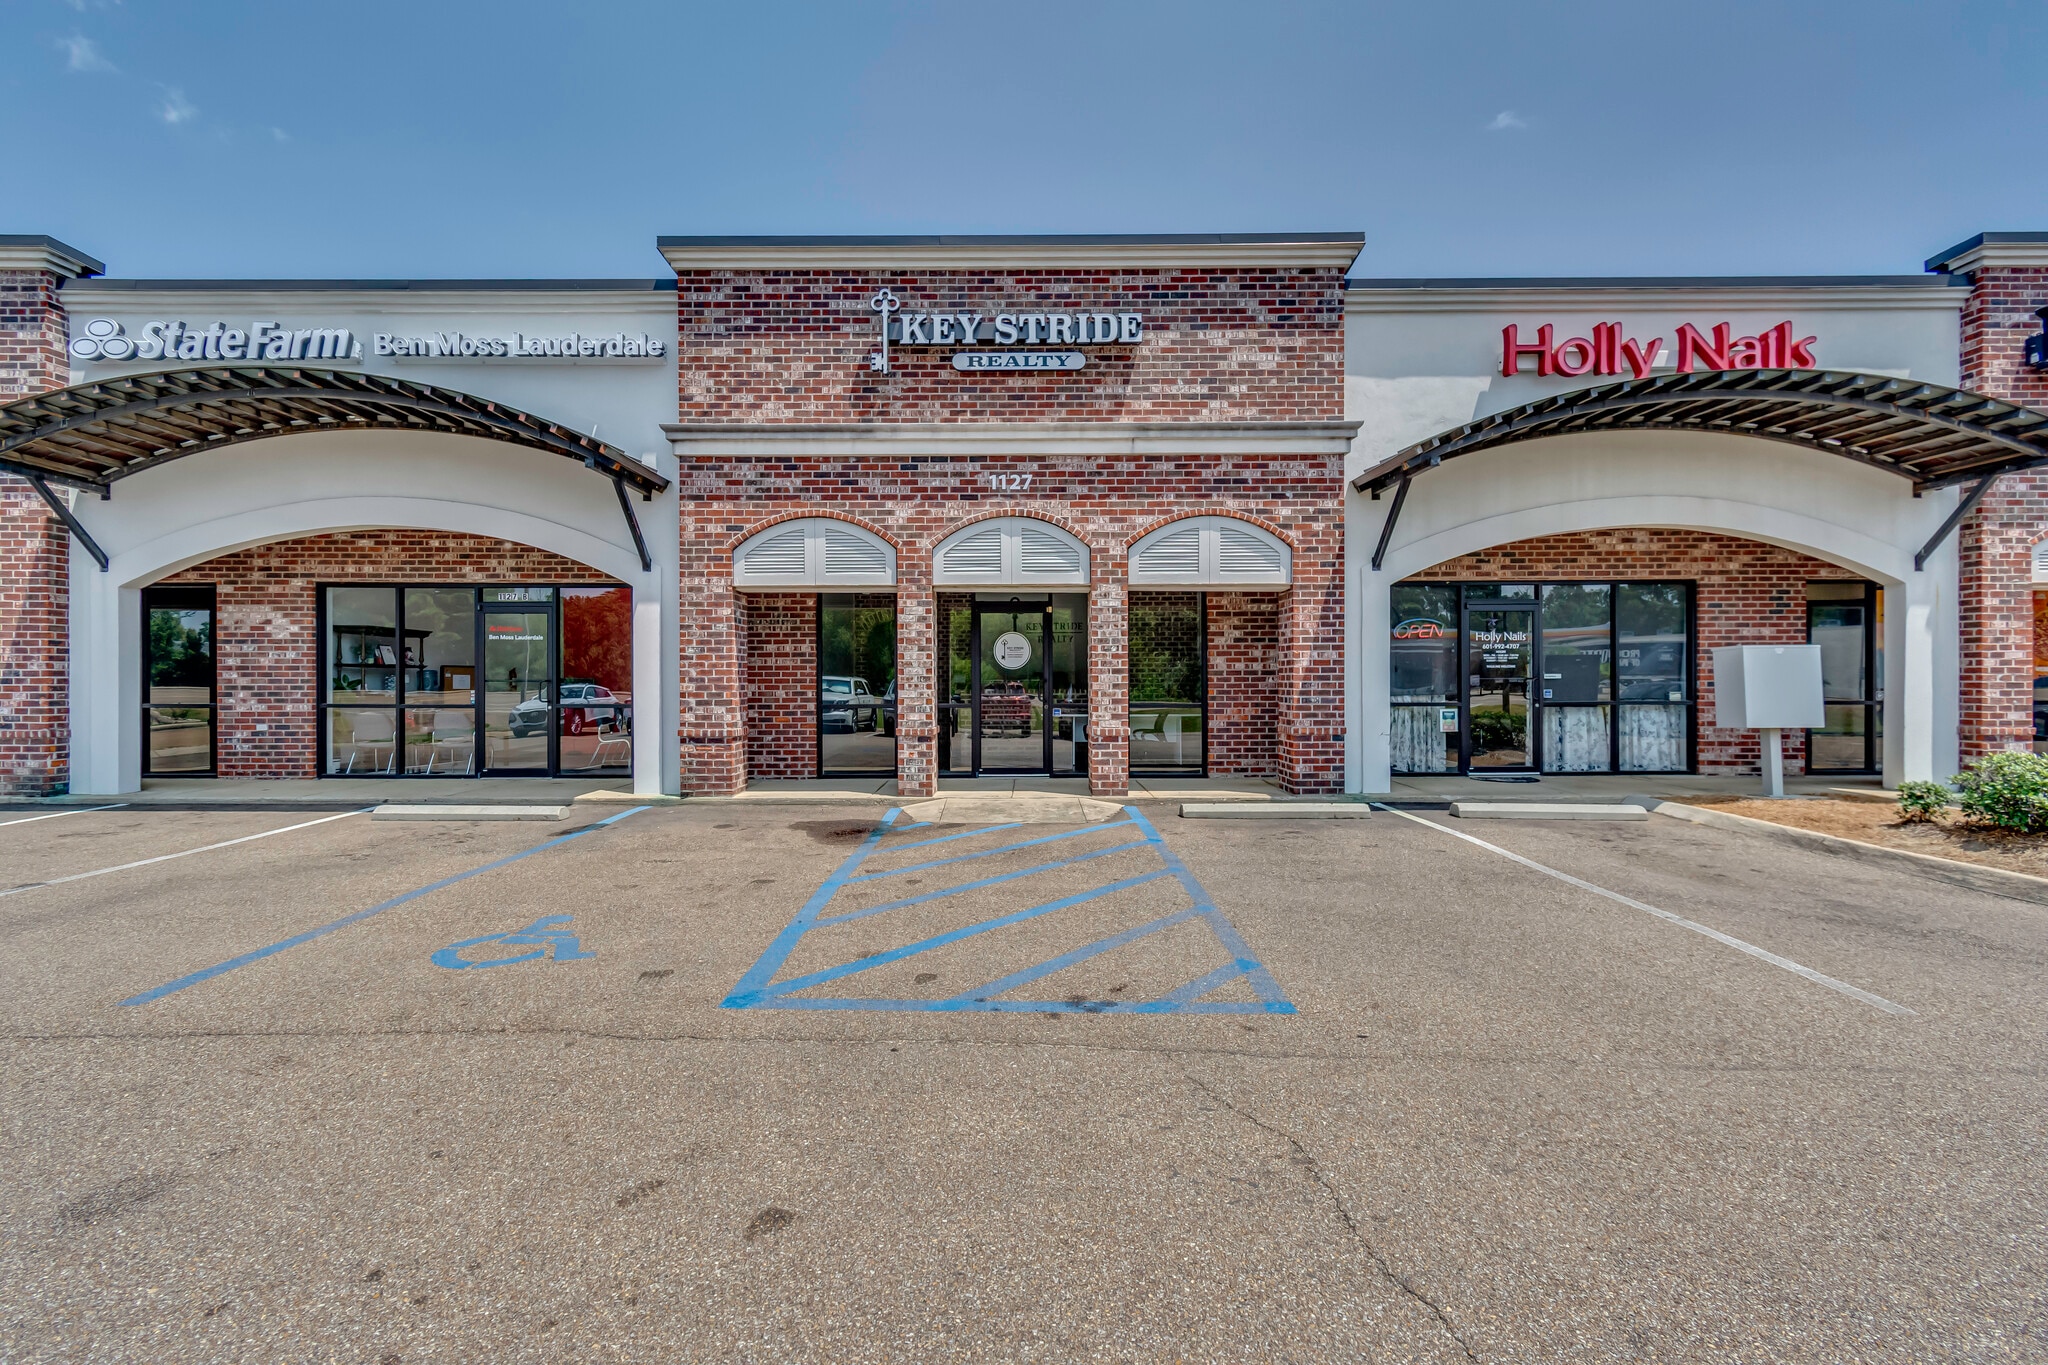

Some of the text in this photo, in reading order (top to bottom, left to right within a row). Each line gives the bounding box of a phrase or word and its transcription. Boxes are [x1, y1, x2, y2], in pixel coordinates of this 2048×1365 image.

[900, 313, 1143, 345] KEY STRIDE
[374, 331, 666, 357] Ben Moss Lauderdale
[1502, 320, 1817, 378] Holly Nails
[966, 355, 1071, 367] REALTY
[989, 474, 1033, 490] 1127
[498, 593, 518, 601] 1127
[1396, 623, 1444, 639] OPEN
[1475, 631, 1527, 643] Holly Nails
